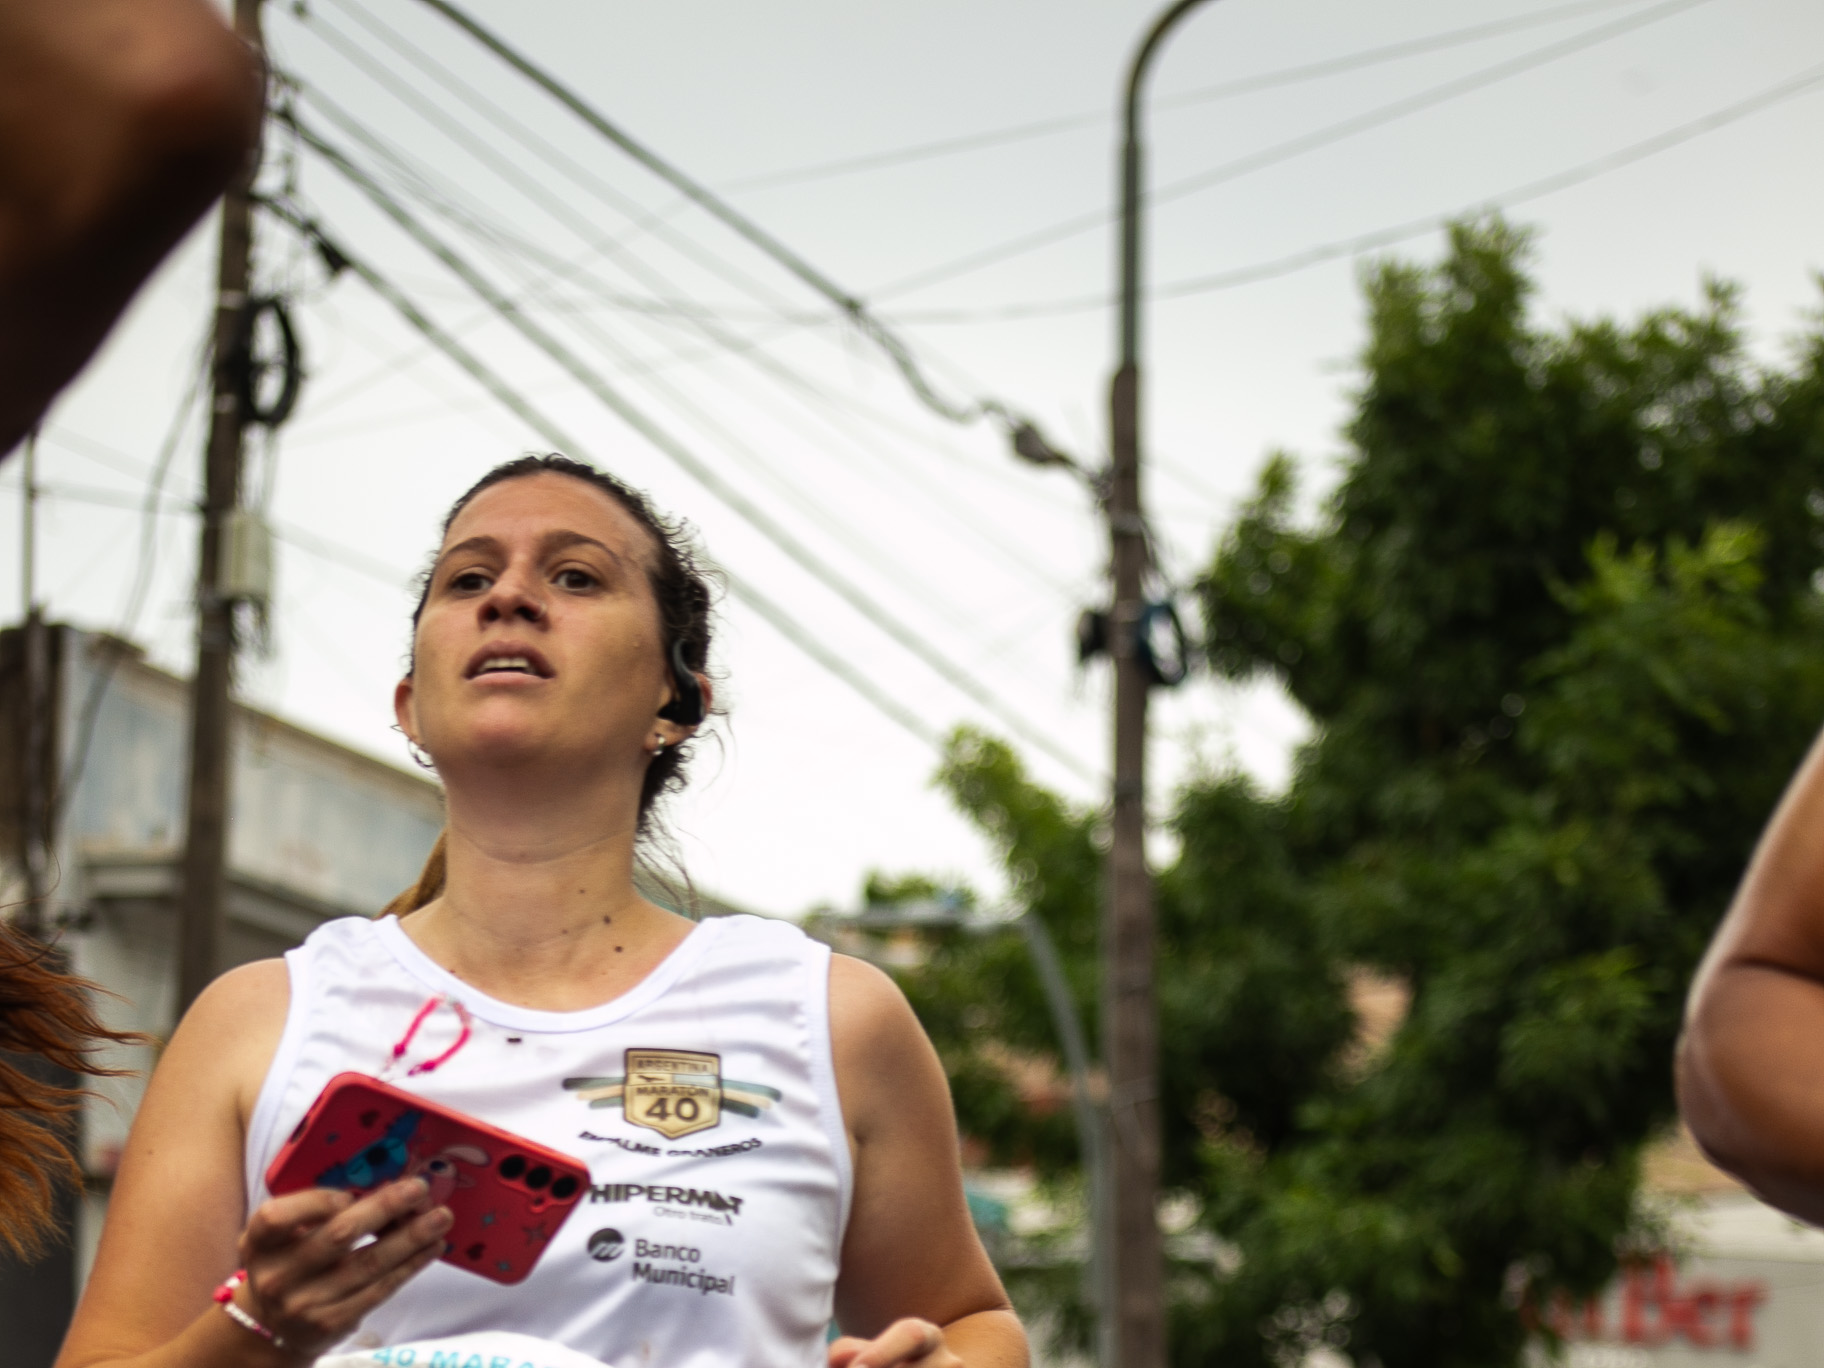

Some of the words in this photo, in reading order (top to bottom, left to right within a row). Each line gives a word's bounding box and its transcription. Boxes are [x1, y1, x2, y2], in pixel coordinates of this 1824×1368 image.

[645, 1097, 699, 1122] 40
[635, 1239, 701, 1263] Banco
[632, 1262, 736, 1296] Municipal
[373, 1346, 417, 1368] 40
